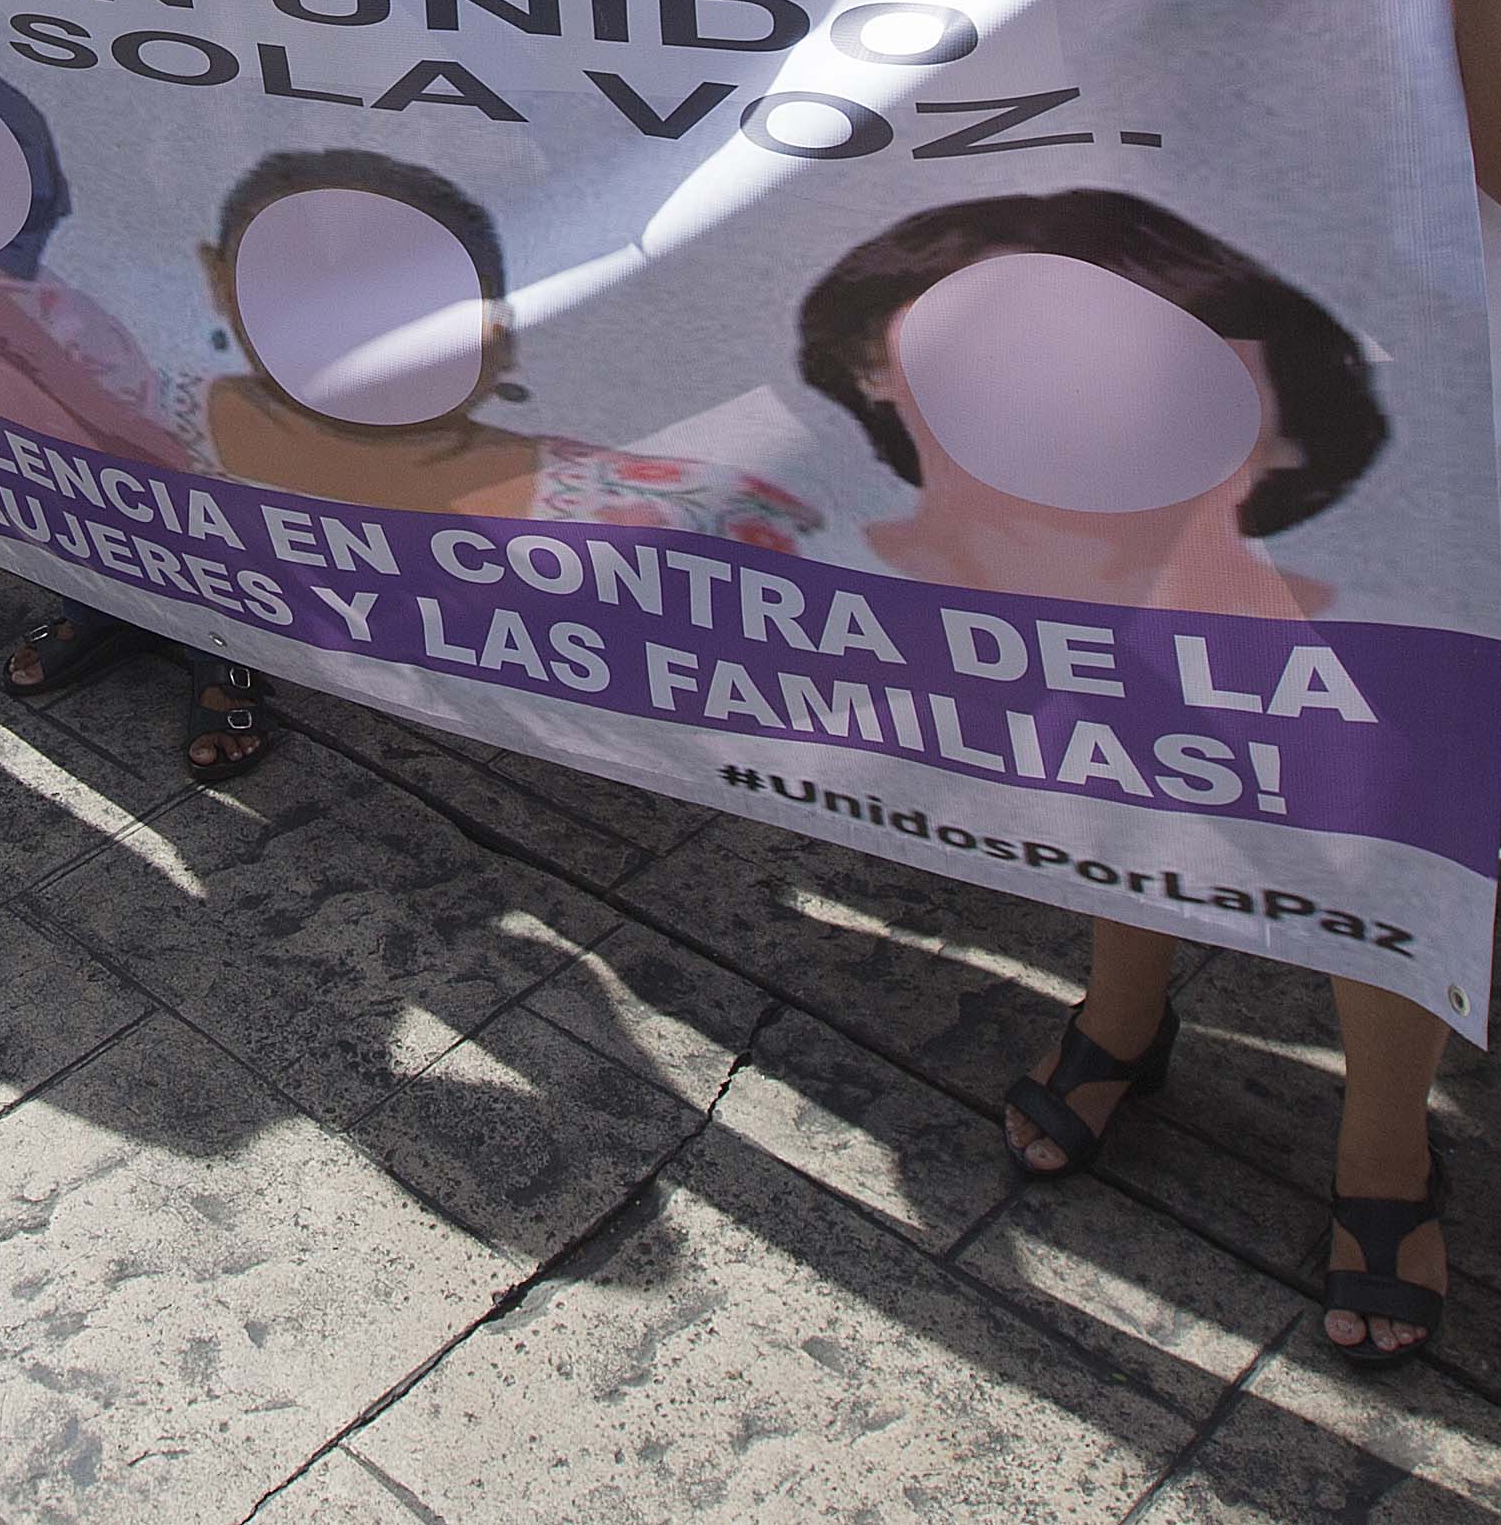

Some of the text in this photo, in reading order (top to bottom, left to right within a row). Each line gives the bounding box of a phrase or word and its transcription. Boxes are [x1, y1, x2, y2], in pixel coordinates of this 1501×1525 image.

[9, 12, 529, 124] SOLA
[259, 504, 401, 576] EN
[430, 528, 906, 665] CONTRA
[939, 607, 1124, 700] DE
[1176, 634, 1379, 724] LA
[309, 585, 379, 643] Y
[416, 595, 611, 693] LAS
[645, 641, 1287, 816] FAMILIAS!
[718, 763, 1415, 959] #UnidosPorLaPaz
